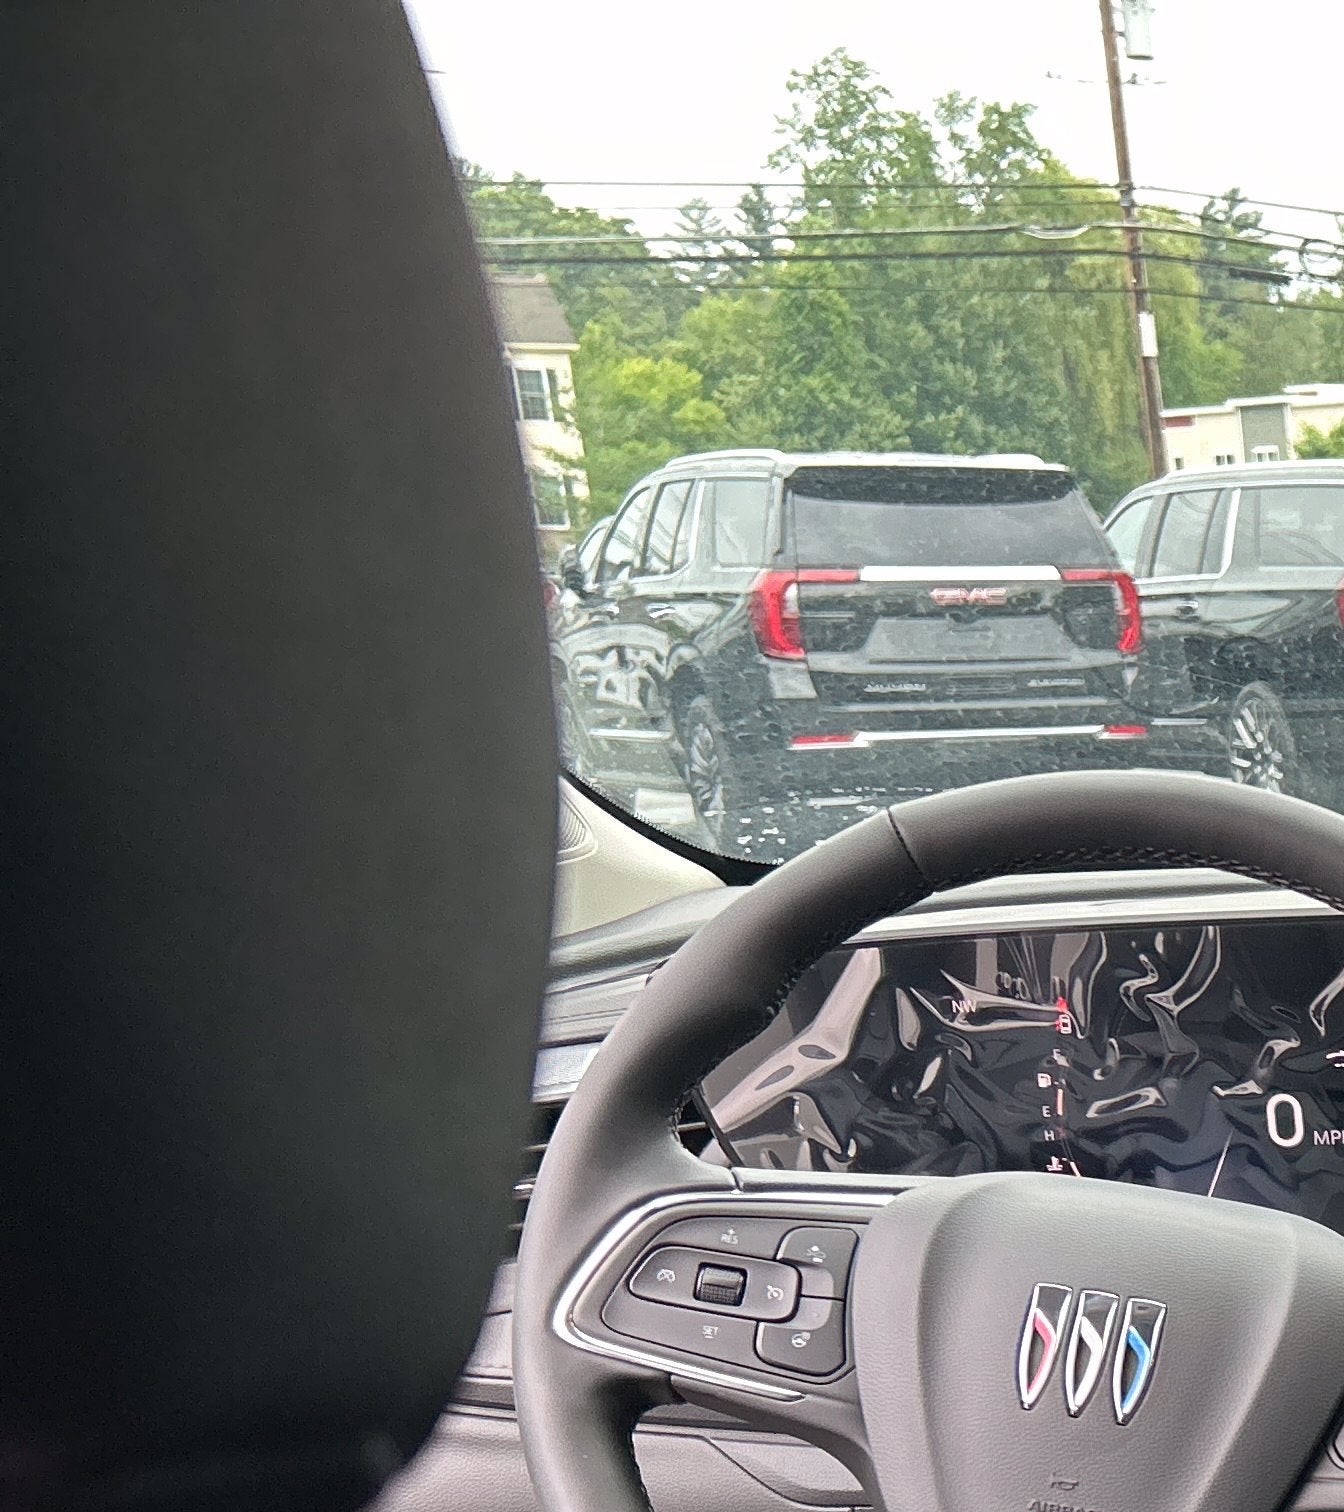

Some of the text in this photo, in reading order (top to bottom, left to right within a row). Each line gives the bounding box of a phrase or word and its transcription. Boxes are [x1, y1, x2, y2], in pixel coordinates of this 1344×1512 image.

[931, 588, 1007, 605] GMC
[952, 1000, 977, 1013] NW
[1042, 1106, 1050, 1117] E
[1265, 1093, 1305, 1148] 0
[1044, 1130, 1055, 1141] H
[702, 1326, 719, 1336] SET
